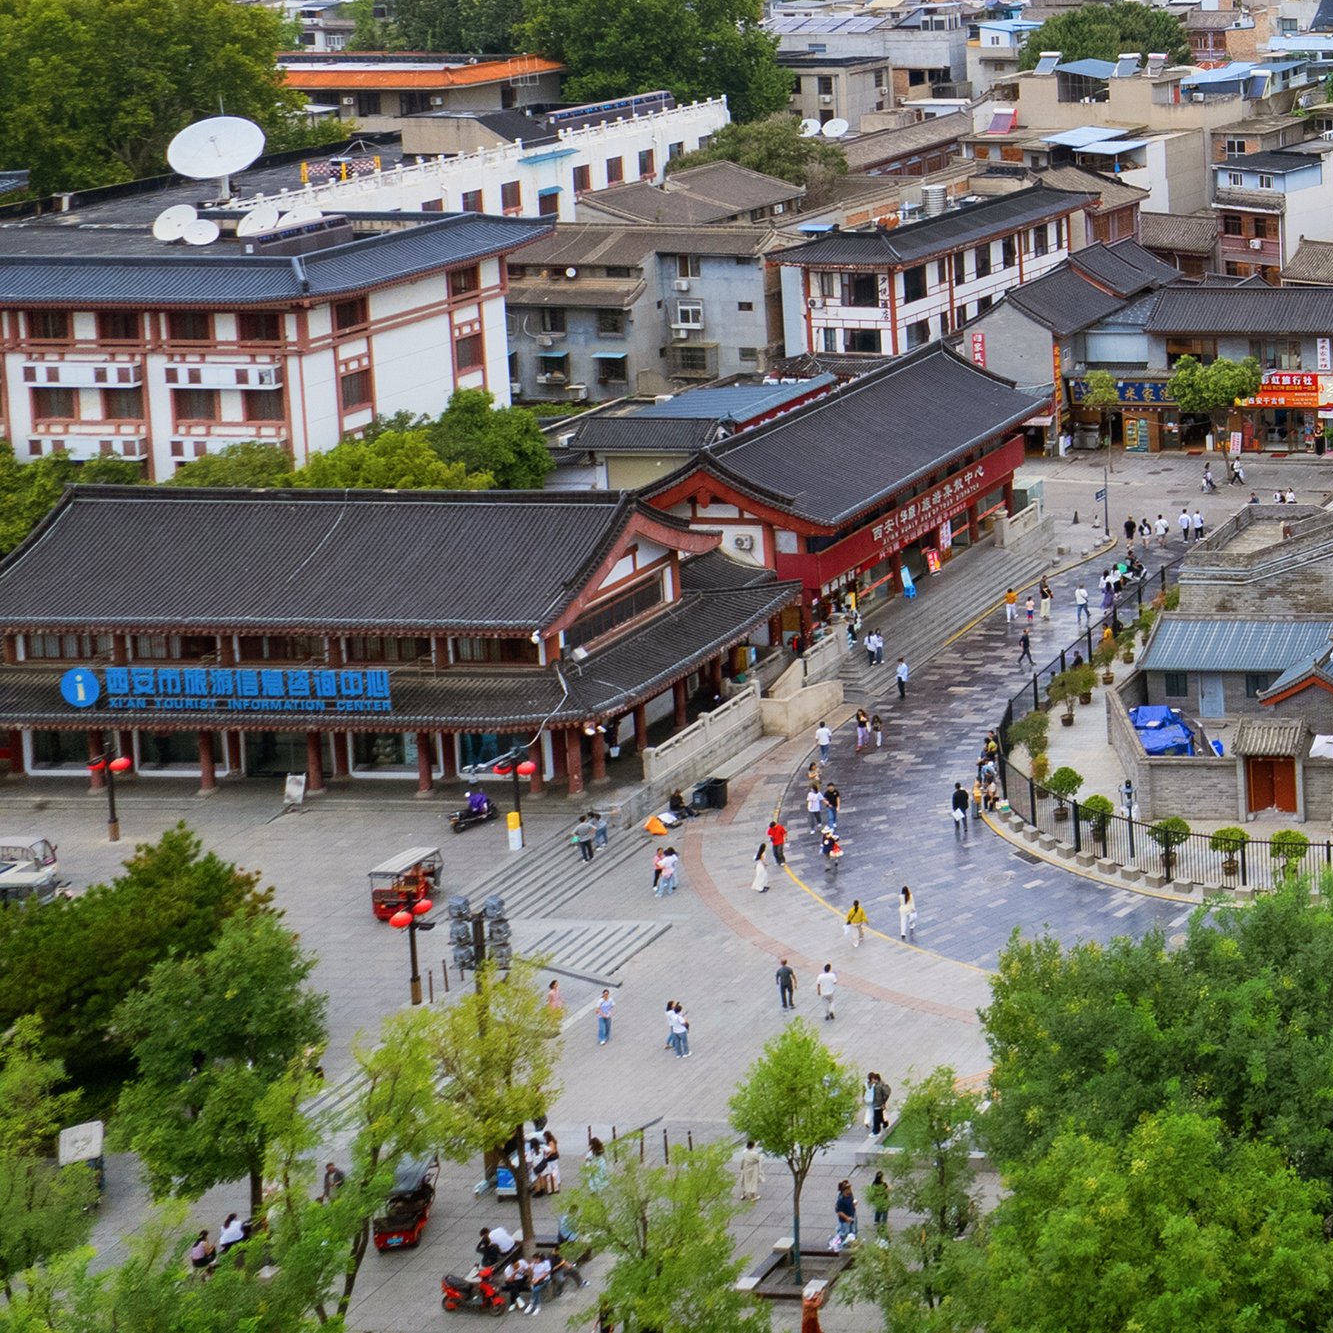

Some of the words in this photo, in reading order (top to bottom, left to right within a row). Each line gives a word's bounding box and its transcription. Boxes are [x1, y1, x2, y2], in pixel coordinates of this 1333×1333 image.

[105, 667, 390, 698] 西安市旅游信息咨询中心
[109, 698, 146, 709] XI'AN
[154, 698, 217, 710] TOURIST
[227, 699, 325, 711] INFORMATION
[336, 700, 392, 711] CENTER
